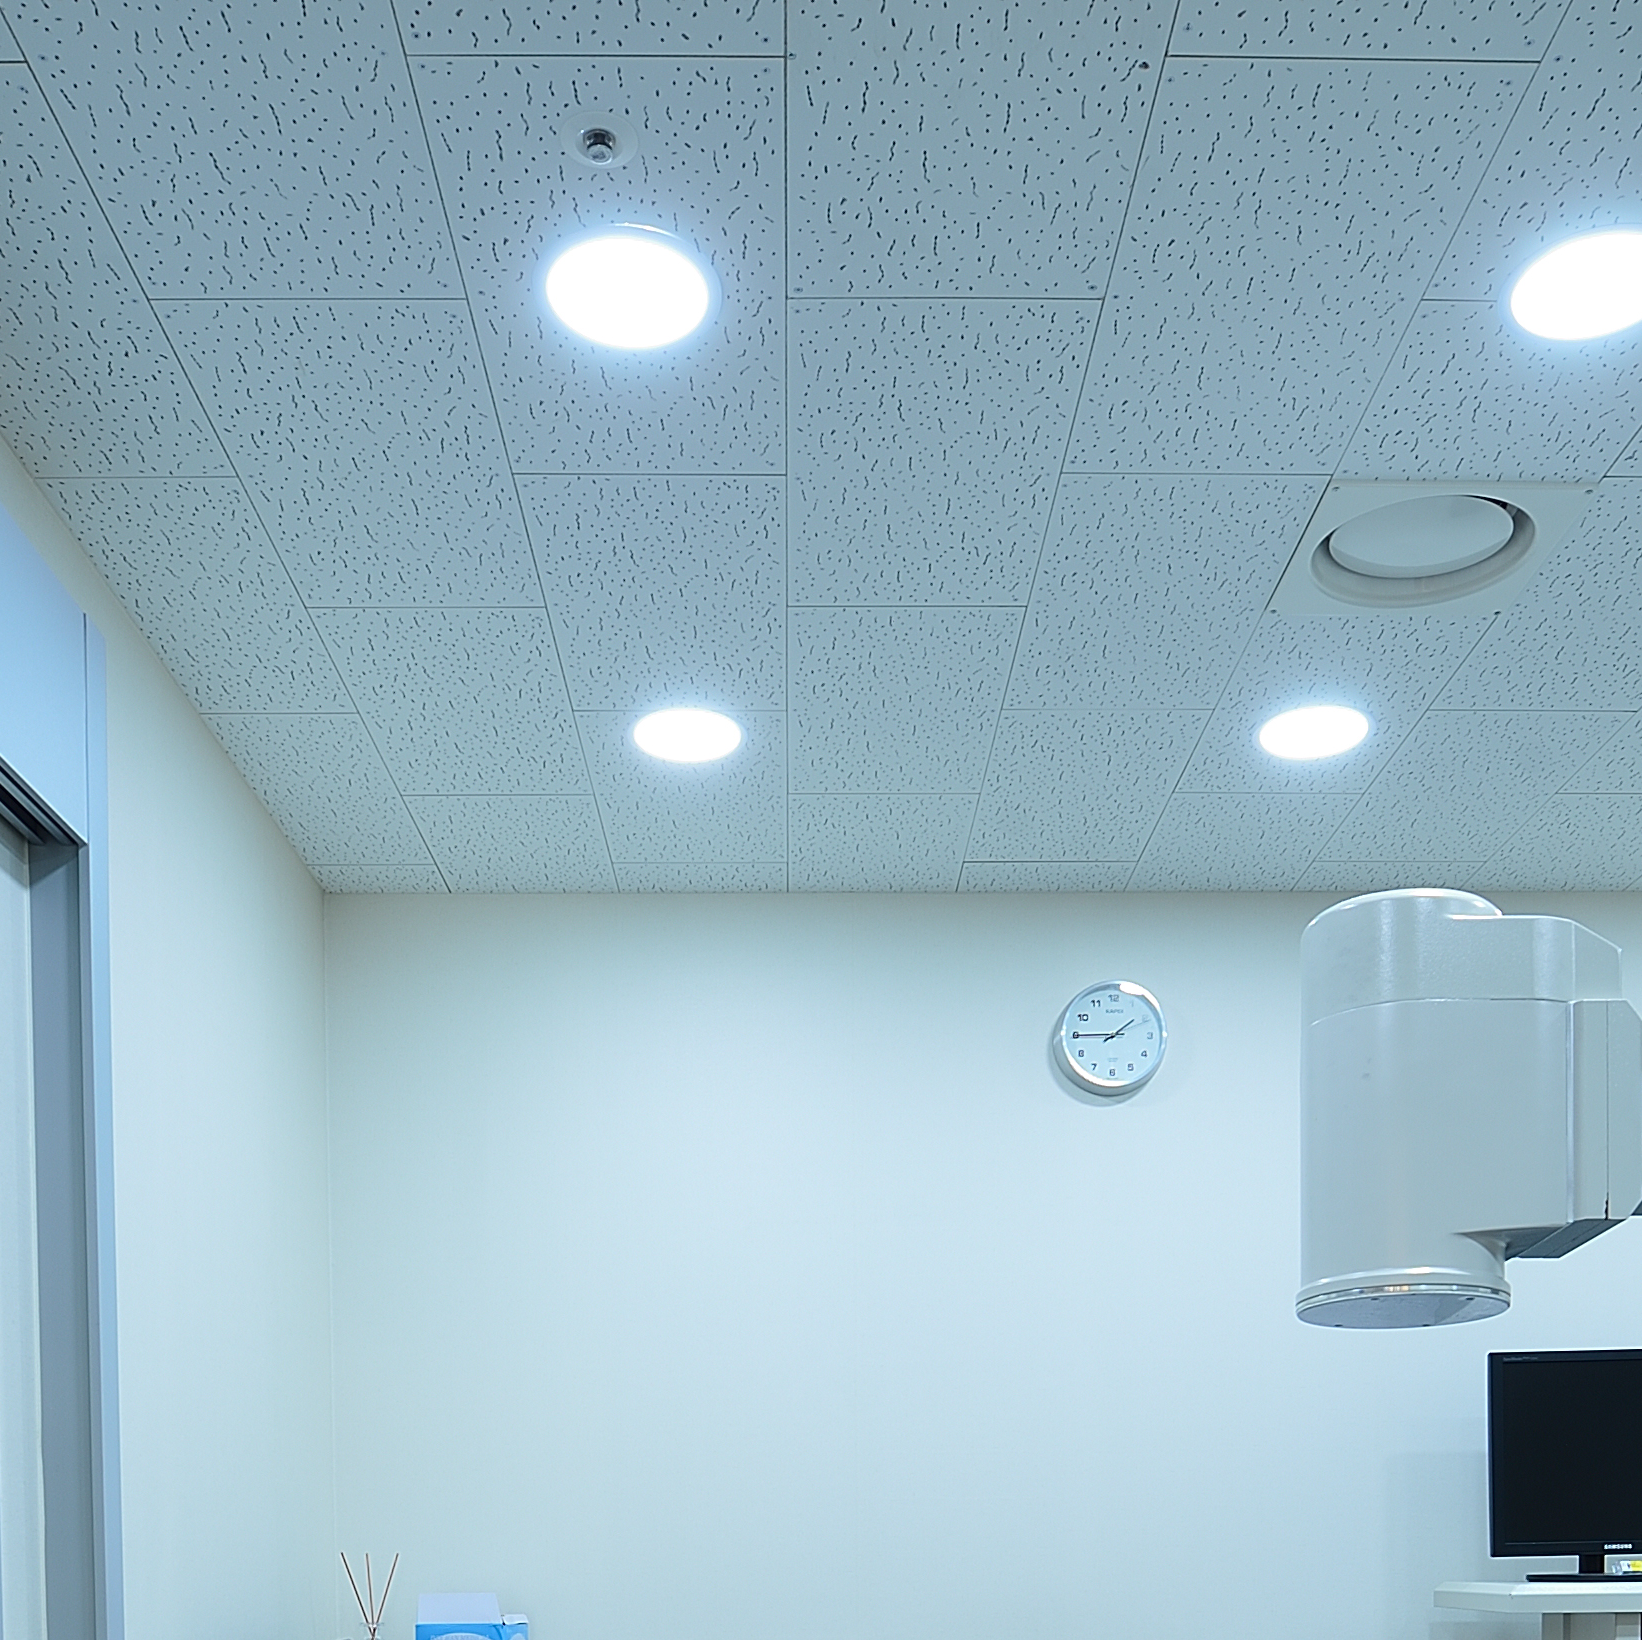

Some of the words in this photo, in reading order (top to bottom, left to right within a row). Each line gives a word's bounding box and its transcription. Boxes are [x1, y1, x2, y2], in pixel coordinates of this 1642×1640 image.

[1108, 994, 1119, 1002] 12
[1091, 999, 1101, 1007] 11
[1147, 1032, 1153, 1040] 3
[1141, 1050, 1148, 1058] 4
[1091, 1063, 1098, 1071] 7
[1128, 1063, 1134, 1071] 5
[1109, 1069, 1115, 1077] 6
